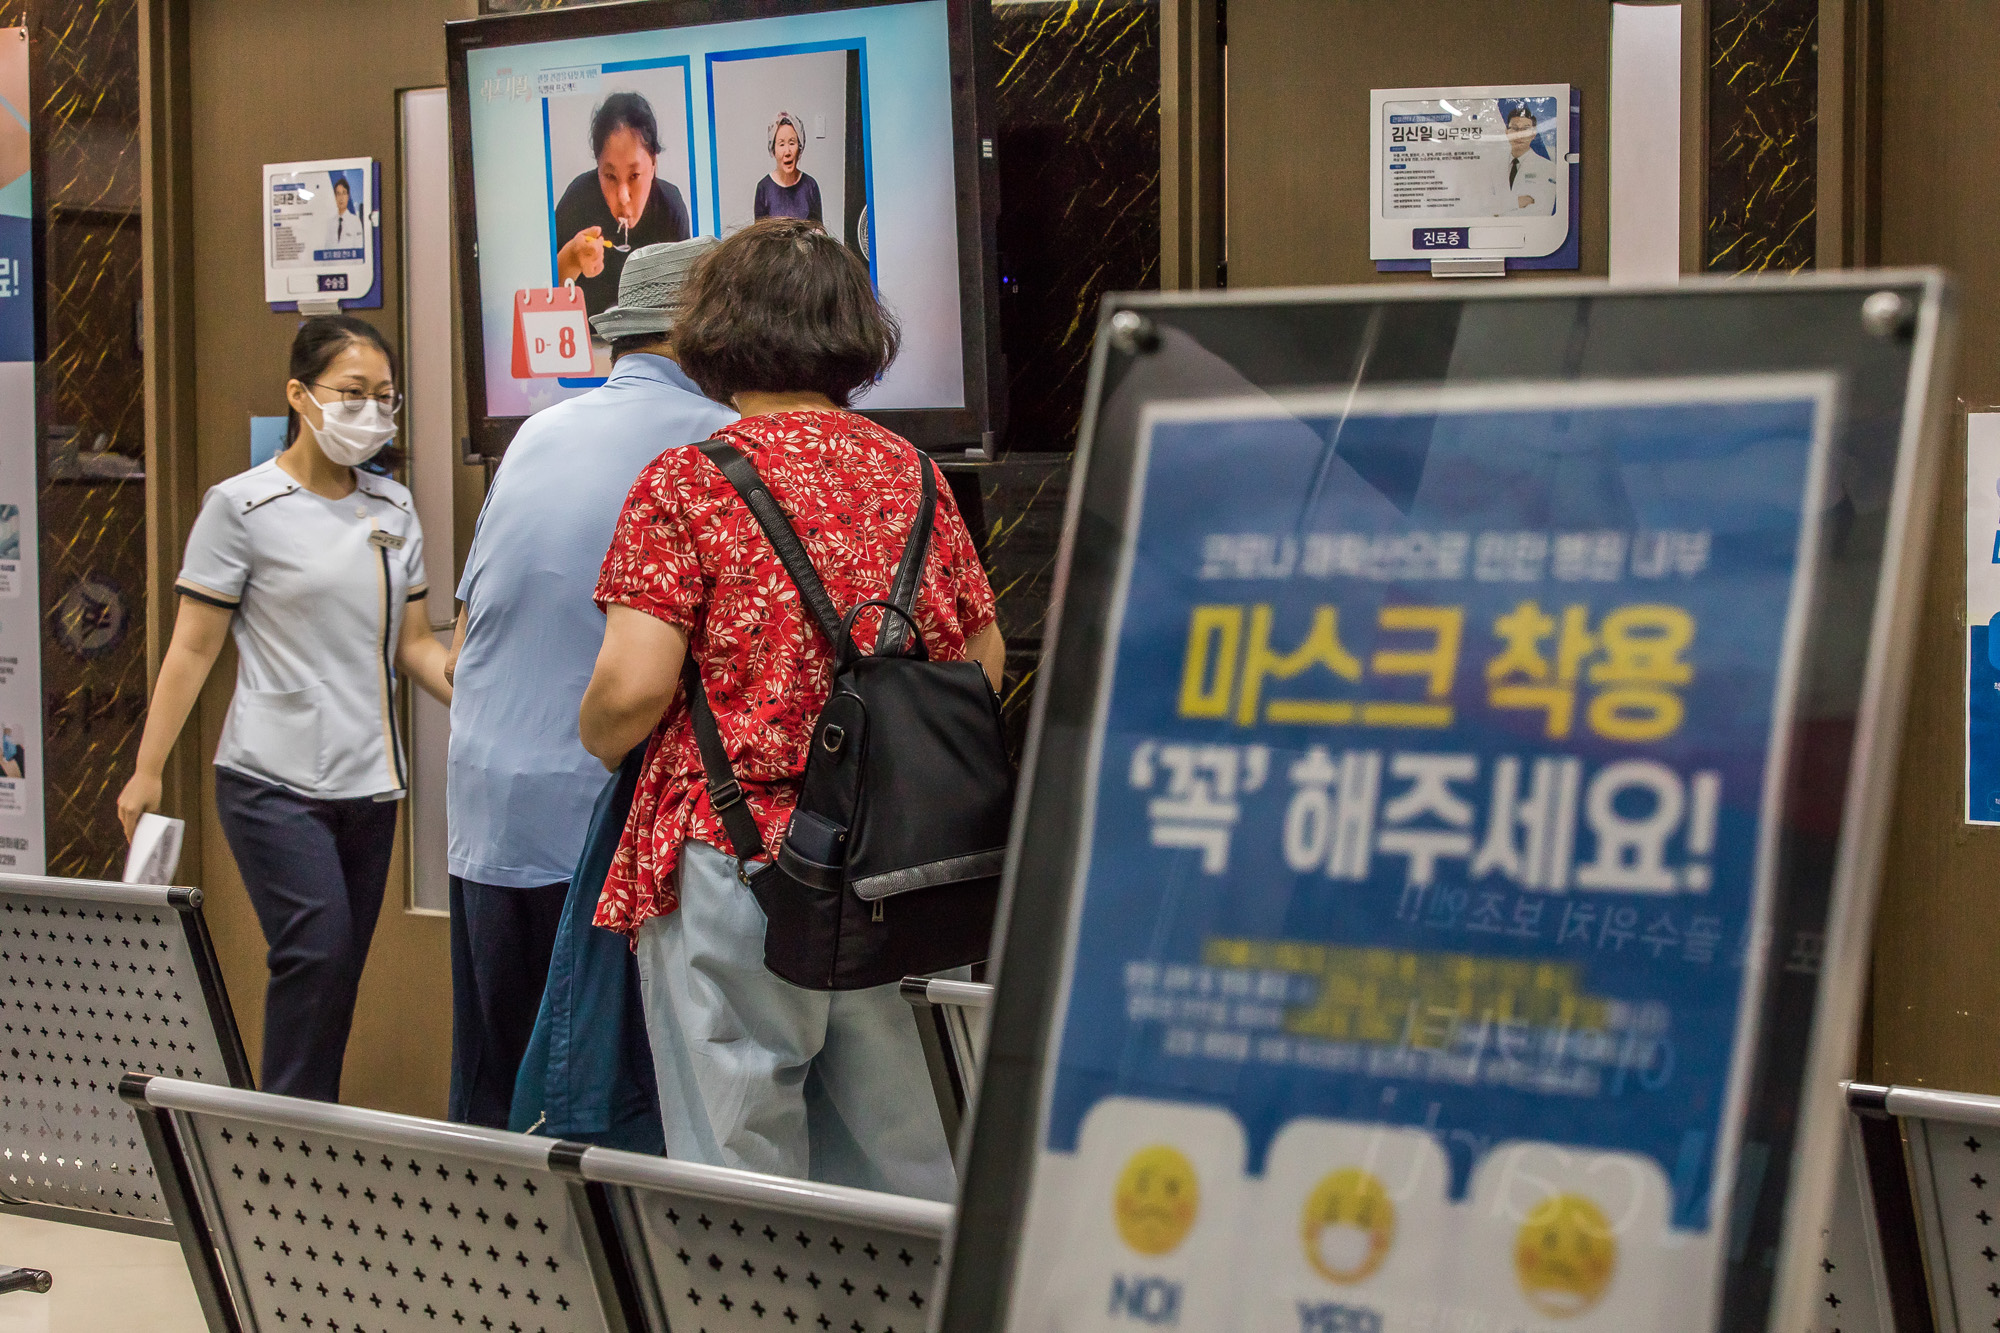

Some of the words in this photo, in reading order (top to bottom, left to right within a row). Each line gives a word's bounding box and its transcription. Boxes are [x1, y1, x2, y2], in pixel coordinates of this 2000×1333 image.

[1392, 126, 1433, 142] 김신일
[1437, 127, 1483, 140] 의무원장
[1423, 231, 1461, 246] 진료중
[324, 276, 346, 289] 수술중
[1178, 603, 1464, 728] 마스크
[1485, 601, 1696, 742] 착용
[1282, 745, 1721, 893] 해주세요!
